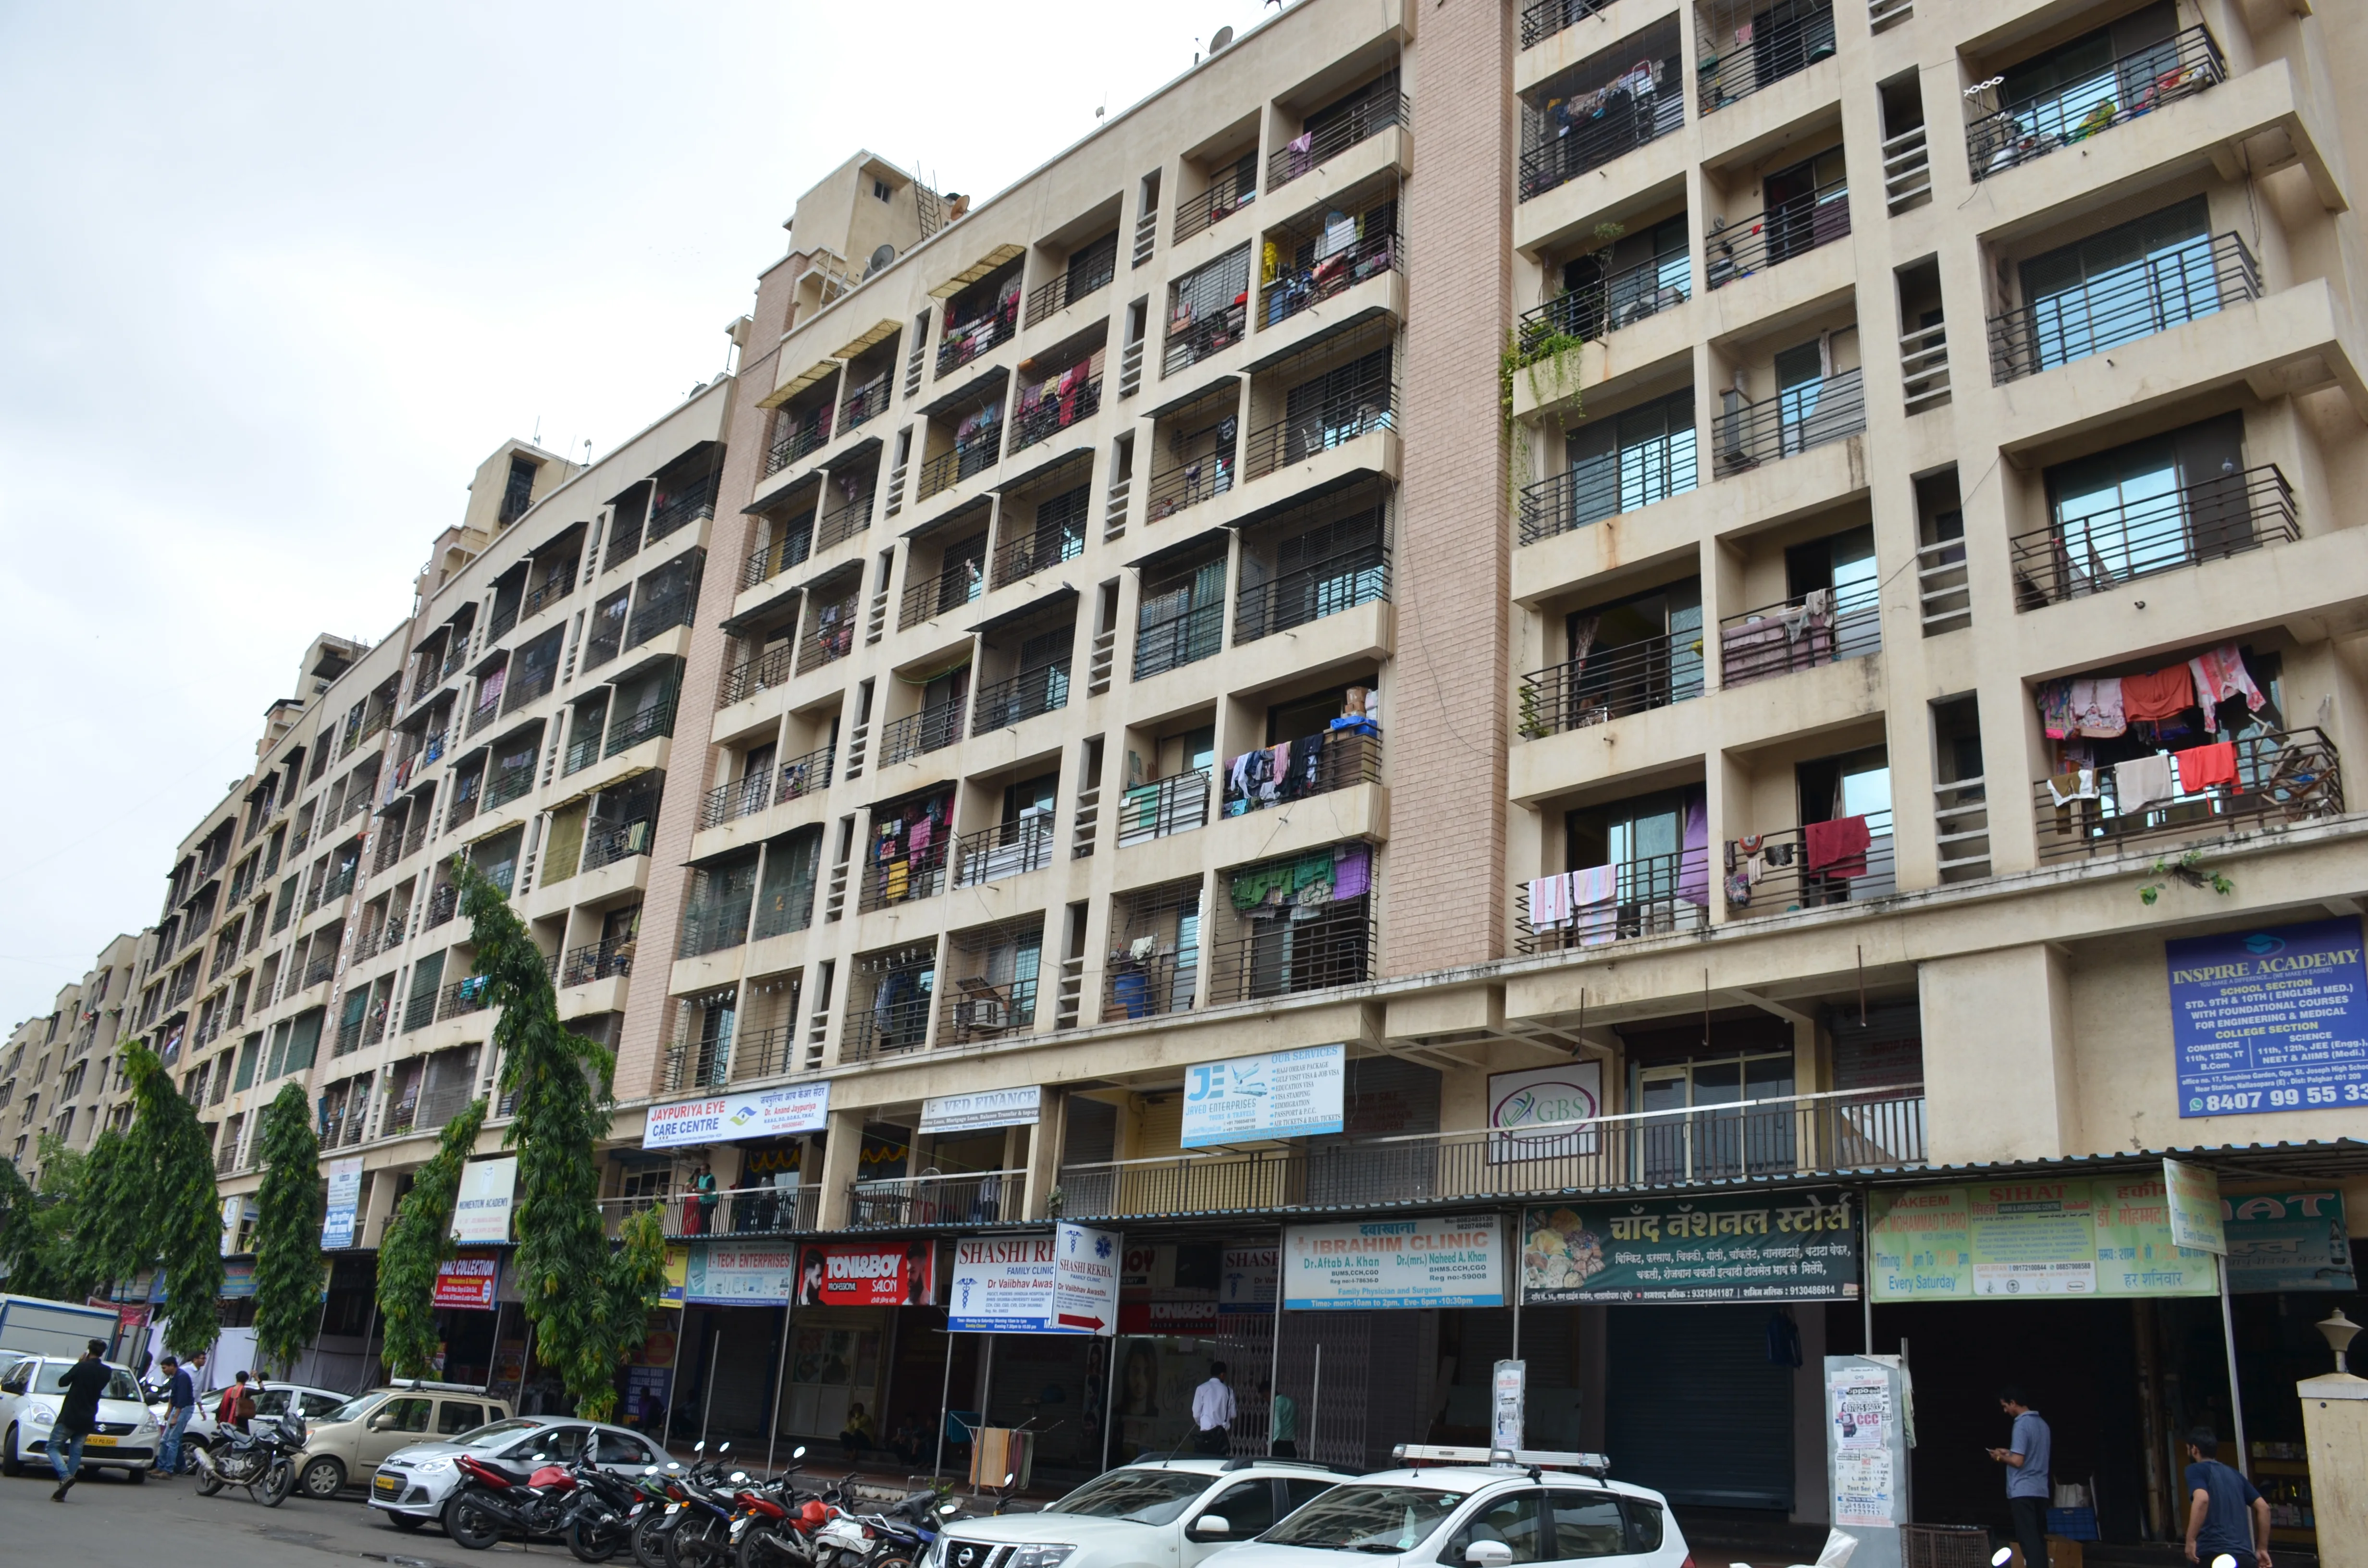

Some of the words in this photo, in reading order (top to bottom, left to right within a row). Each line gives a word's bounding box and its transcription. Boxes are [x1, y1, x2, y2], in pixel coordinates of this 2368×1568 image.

[2173, 962, 2249, 984] INSPIRE
[2257, 949, 2359, 975] ACADEMY
[2220, 985, 2262, 996] SCHOOL
[2266, 979, 2313, 991] SECTION
[2185, 1000, 2207, 1009] STD.
[2209, 998, 2228, 1006] 9TH
[2242, 993, 2267, 1003] 10TH
[2276, 988, 2321, 1000] ENGLISH
[2323, 984, 2353, 995] MED.)
[2191, 1010, 2216, 1019] WITH
[2219, 1001, 2296, 1017] FOUNDATIONAL
[2299, 995, 2349, 1008] COURSES
[2195, 1021, 2215, 1029] FOR
[2217, 1014, 2286, 1028] ENGINEERING
[2300, 1008, 2346, 1019] MEDICAL
[2215, 1027, 2266, 1039] COLLEGE
[2269, 1022, 2319, 1034] SECTION
[2289, 1032, 2332, 1042] SCIENCE
[2187, 1041, 2240, 1053] COMMERCE
[2284, 1044, 2307, 1053] 12th,
[1271, 1052, 1290, 1064] OUR
[1293, 1046, 1338, 1061] SERVICES
[2210, 1052, 2232, 1061] 12th,
[2263, 1055, 2288, 1064] NEET
[1289, 1065, 1306, 1073] OMRAH
[1307, 1061, 1329, 1070] PACKAGE
[2201, 1062, 2230, 1071] B.Com
[2223, 1074, 2251, 1082] Sunshine
[2306, 1067, 2330, 1076] Joseph
[2332, 1066, 2347, 1074] High
[1275, 1083, 1302, 1091] EDUCATION
[944, 1099, 971, 1112] VED
[975, 1090, 1036, 1110] FINANCE
[1286, 1090, 1310, 1099] STAMPING
[2207, 1092, 2262, 1112] 8407
[2270, 1089, 2299, 1106] 99
[2307, 1086, 2337, 1103] 55
[651, 1104, 702, 1121] JAYPURIYA
[706, 1101, 725, 1115] EYE
[774, 1105, 790, 1115] Anand
[791, 1102, 816, 1113] Jaypuriya
[1186, 1104, 1206, 1115] JAVED
[1209, 1098, 1256, 1113] ENTERPRISES
[1274, 1100, 1310, 1109] EIMMIGRATION
[1537, 1097, 1584, 1122] GBS
[1233, 1110, 1255, 1118] TRAVELS
[1274, 1110, 1298, 1118] PASSPORT
[653, 1123, 678, 1137] CARE
[680, 1117, 719, 1133] CENTRE
[1283, 1118, 1303, 1126] TICKETS
[1990, 1184, 2068, 1201] SIHAT
[459, 1200, 485, 1210] MOMENTUM
[486, 1198, 509, 1207] ACADEMY
[1890, 1195, 1949, 1209] HAKEEM
[1972, 1201, 1996, 1215] सिहत
[2043, 1202, 2060, 1210] CENTRE
[1610, 1203, 1661, 1243] चाँद
[1666, 1202, 1769, 1238] नॅशनल
[1776, 1192, 1852, 1233] स्टोर्स
[2118, 1203, 2162, 1226] मोहम्मद
[1359, 1222, 1417, 1236] दवाखाना
[1875, 1217, 1887, 1234] DR.
[1890, 1213, 1938, 1233] MOHAMMAD
[1942, 1212, 1966, 1230] TARIQ
[1313, 1236, 1402, 1255] IBRAHIM
[1410, 1232, 1488, 1251] CLINIC
[959, 1241, 1029, 1264] SHASHI
[1429, 1251, 1457, 1264] Naheed
[1468, 1251, 1487, 1262] Khan
[1706, 1249, 1727, 1262] गोली,
[717, 1253, 735, 1267] TECH
[739, 1253, 789, 1267] ENTERPRISES
[826, 1254, 902, 1279] TONI&BOY
[1304, 1256, 1342, 1269] Dr.Aftab
[1345, 1257, 1354, 1267] A.
[1357, 1256, 1380, 1267] Khan
[1876, 1252, 1900, 1271] Timing
[1913, 1254, 1923, 1268] pm
[1926, 1251, 1934, 1265] To
[1959, 1253, 1969, 1267] pm
[440, 1261, 456, 1275] NAAZ
[456, 1260, 495, 1275] COLLECTION
[1007, 1267, 1031, 1275] FAMILY
[1032, 1266, 1054, 1274] CLINIC
[1060, 1259, 1085, 1274] SHASHI
[1087, 1264, 1113, 1278] REKHA.
[988, 1279, 997, 1288] Dr
[999, 1279, 1030, 1288] Vaiibhav
[1889, 1276, 1913, 1293] Every
[1916, 1274, 1956, 1291] Saturday
[2124, 1273, 2138, 1288] हर
[2141, 1269, 2183, 1286] शनिवार
[872, 1280, 897, 1292] SALON
[1065, 1284, 1085, 1294] Vaiibhav
[1086, 1286, 1106, 1296] Awasthi
[1338, 1287, 1360, 1296] Family
[1362, 1287, 1395, 1296] Physician
[1412, 1286, 1442, 1295] Surgeon
[1692, 1288, 1733, 1298] 9321841187
[1790, 1286, 1835, 1295] 9130486814
[1383, 1299, 1400, 1308] 2pm.
[1422, 1298, 1437, 1306] 6pm
[1439, 1297, 1473, 1306] -10:30pm
[630, 1377, 650, 1385] COLLEGE
[1857, 1414, 1878, 1425] CCC
